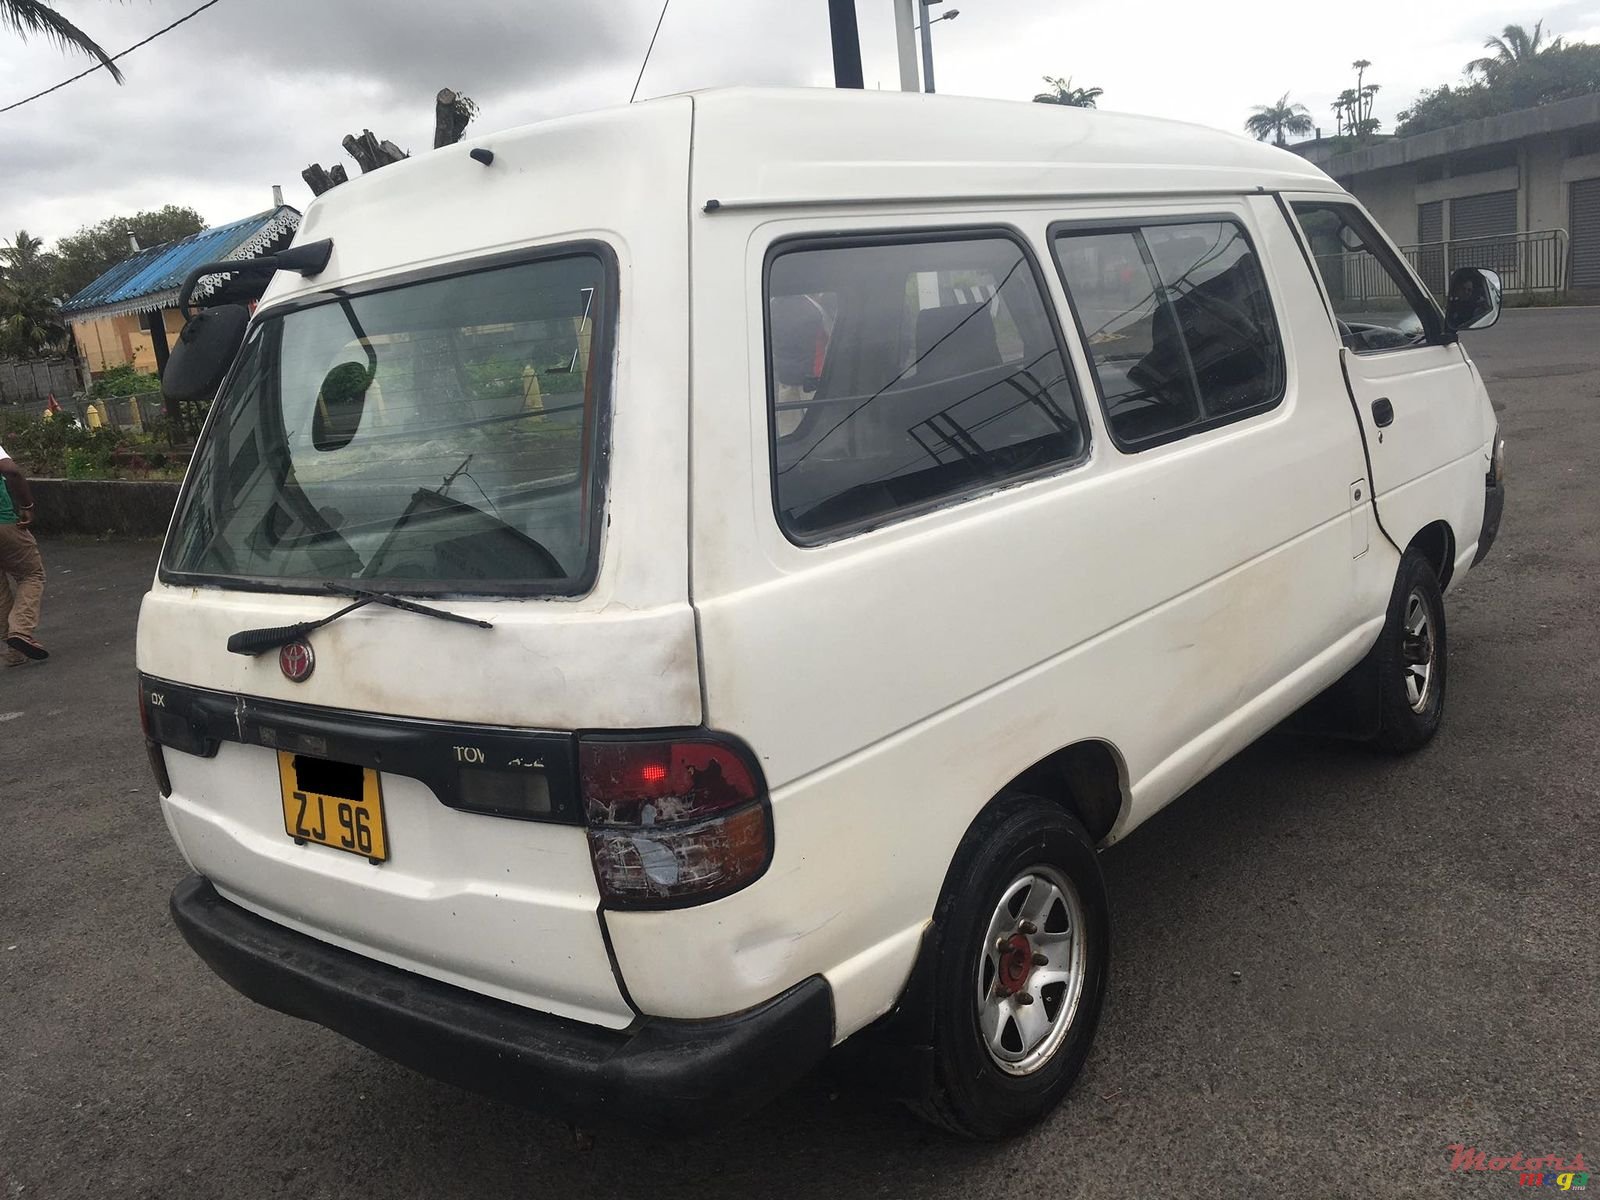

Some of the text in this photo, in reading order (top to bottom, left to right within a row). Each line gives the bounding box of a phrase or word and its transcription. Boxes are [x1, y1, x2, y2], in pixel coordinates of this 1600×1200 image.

[151, 692, 165, 707] DX
[293, 792, 372, 853] ZJ 96
